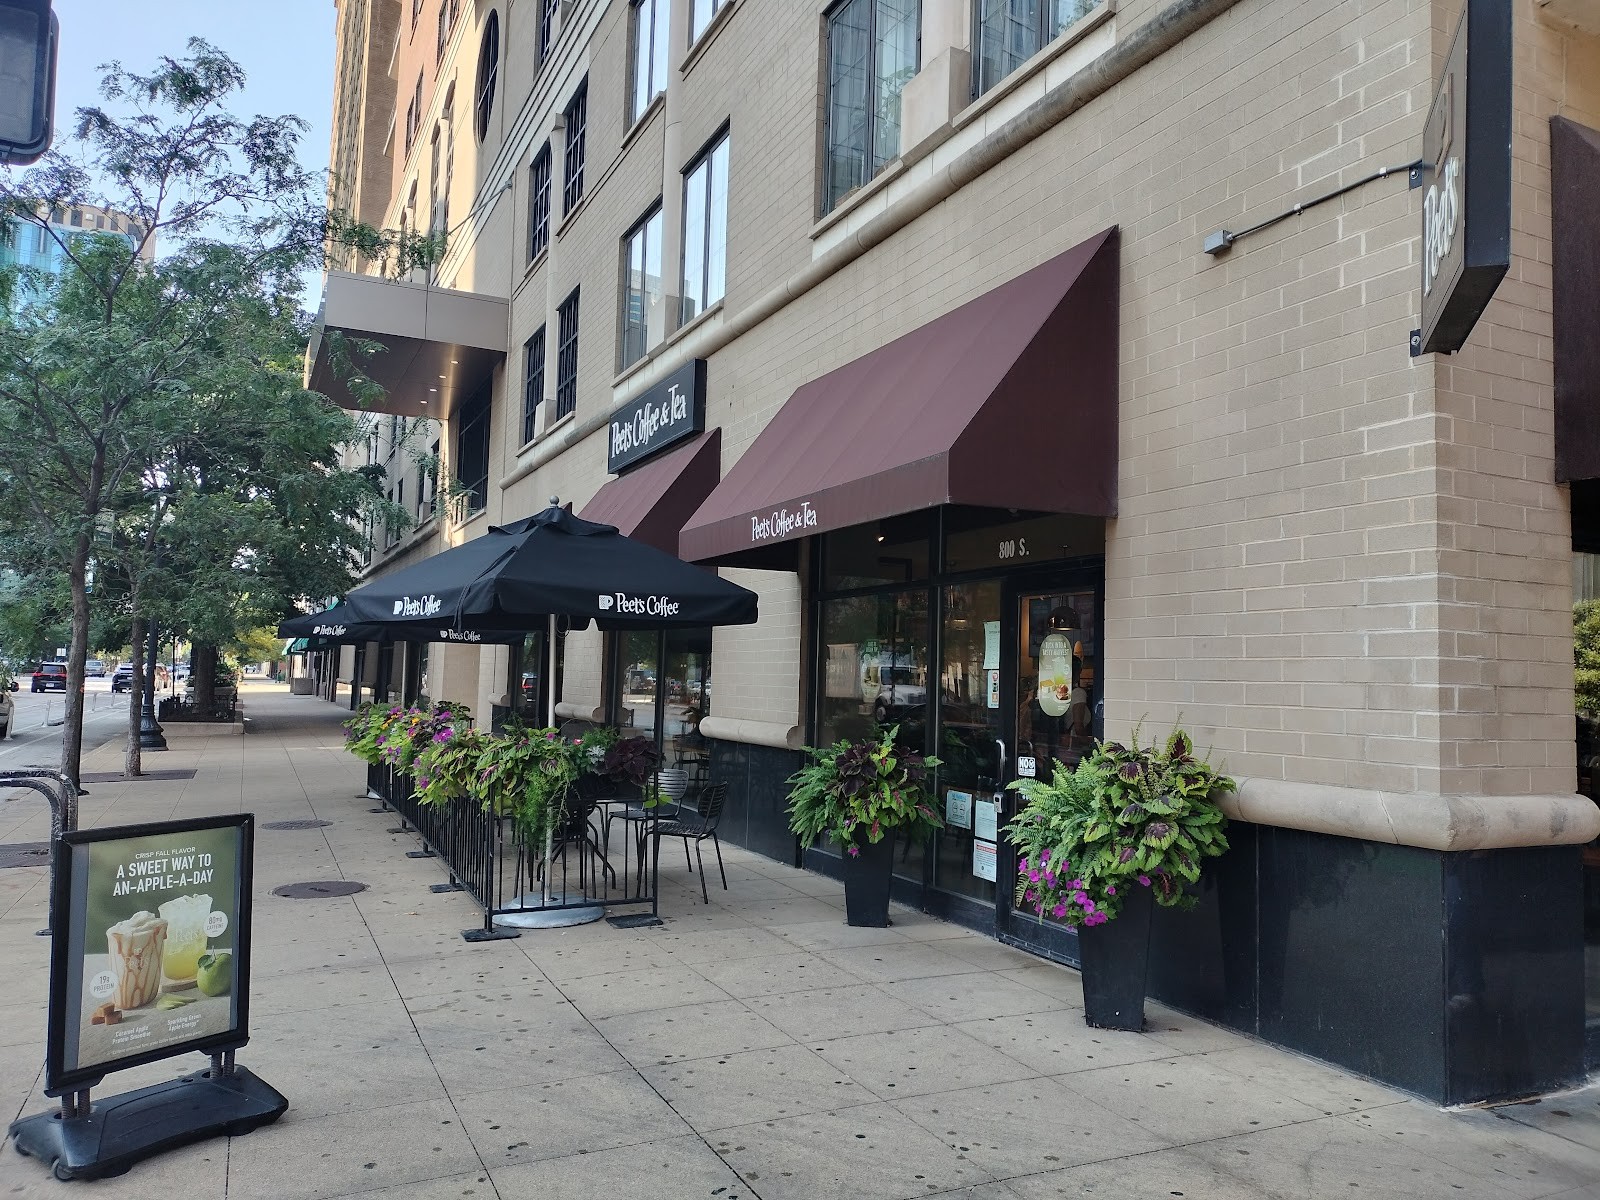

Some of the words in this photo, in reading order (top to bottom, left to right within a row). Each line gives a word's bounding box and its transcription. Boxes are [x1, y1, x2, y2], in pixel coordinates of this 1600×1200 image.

[611, 421, 633, 459] Peet's
[632, 402, 660, 447] Coffee
[660, 401, 670, 426] &
[668, 383, 687, 426] Tea
[751, 516, 770, 542] Peet's
[770, 508, 795, 538] Coffee
[795, 511, 803, 527] &
[800, 501, 818, 529] Tea
[999, 539, 1015, 559] 800
[1019, 537, 1030, 556] S.
[402, 596, 421, 616] Peet's
[420, 594, 442, 616] Coffee
[614, 592, 646, 615] Peet's
[646, 595, 679, 617] Coffee
[331, 624, 347, 636] Coffee
[463, 630, 481, 642] Coffee
[135, 851, 154, 859] CRISP
[155, 849, 170, 857] FALL
[172, 846, 196, 855] FLAVOR
[116, 864, 125, 879] A
[128, 859, 168, 877] SWEET
[172, 855, 195, 871] WAY
[198, 853, 212, 868] TO
[113, 869, 214, 896] AN-APPLE-A-DAY
[93, 983, 115, 992] PROTEIN
